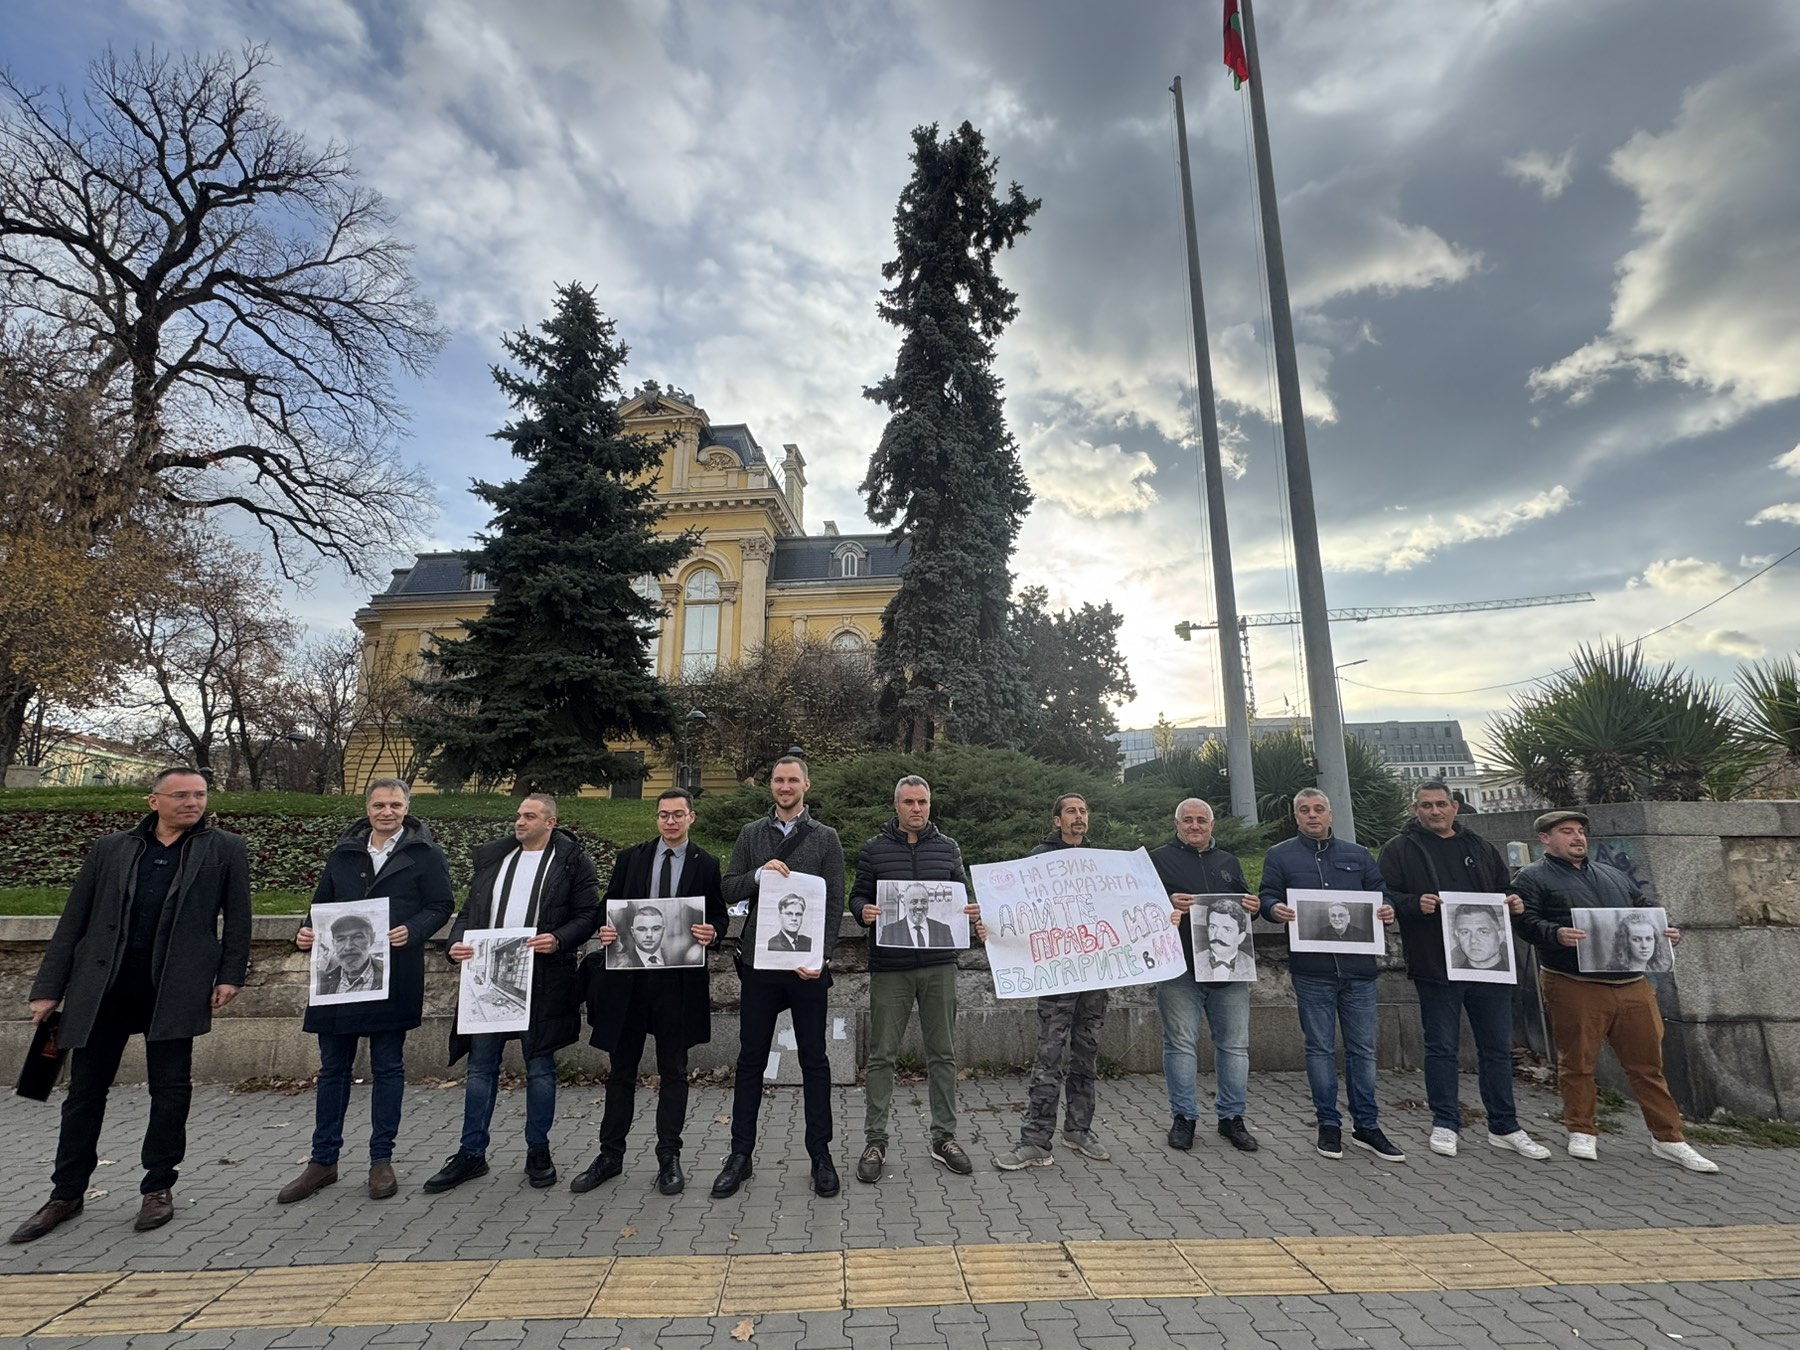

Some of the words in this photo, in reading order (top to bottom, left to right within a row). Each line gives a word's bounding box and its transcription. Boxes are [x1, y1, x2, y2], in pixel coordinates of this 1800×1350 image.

[1018, 867, 1042, 884] НА
[1046, 858, 1098, 878] ЕЗИКА
[1025, 883, 1049, 899] НА
[1052, 874, 1139, 896] ОМРАЗАТА
[999, 893, 1098, 937] ДАЙТЕ
[1029, 920, 1120, 963] ПРАВА
[1122, 902, 1169, 944] НА
[996, 944, 1144, 995] БЪЛГАРИТЕ
